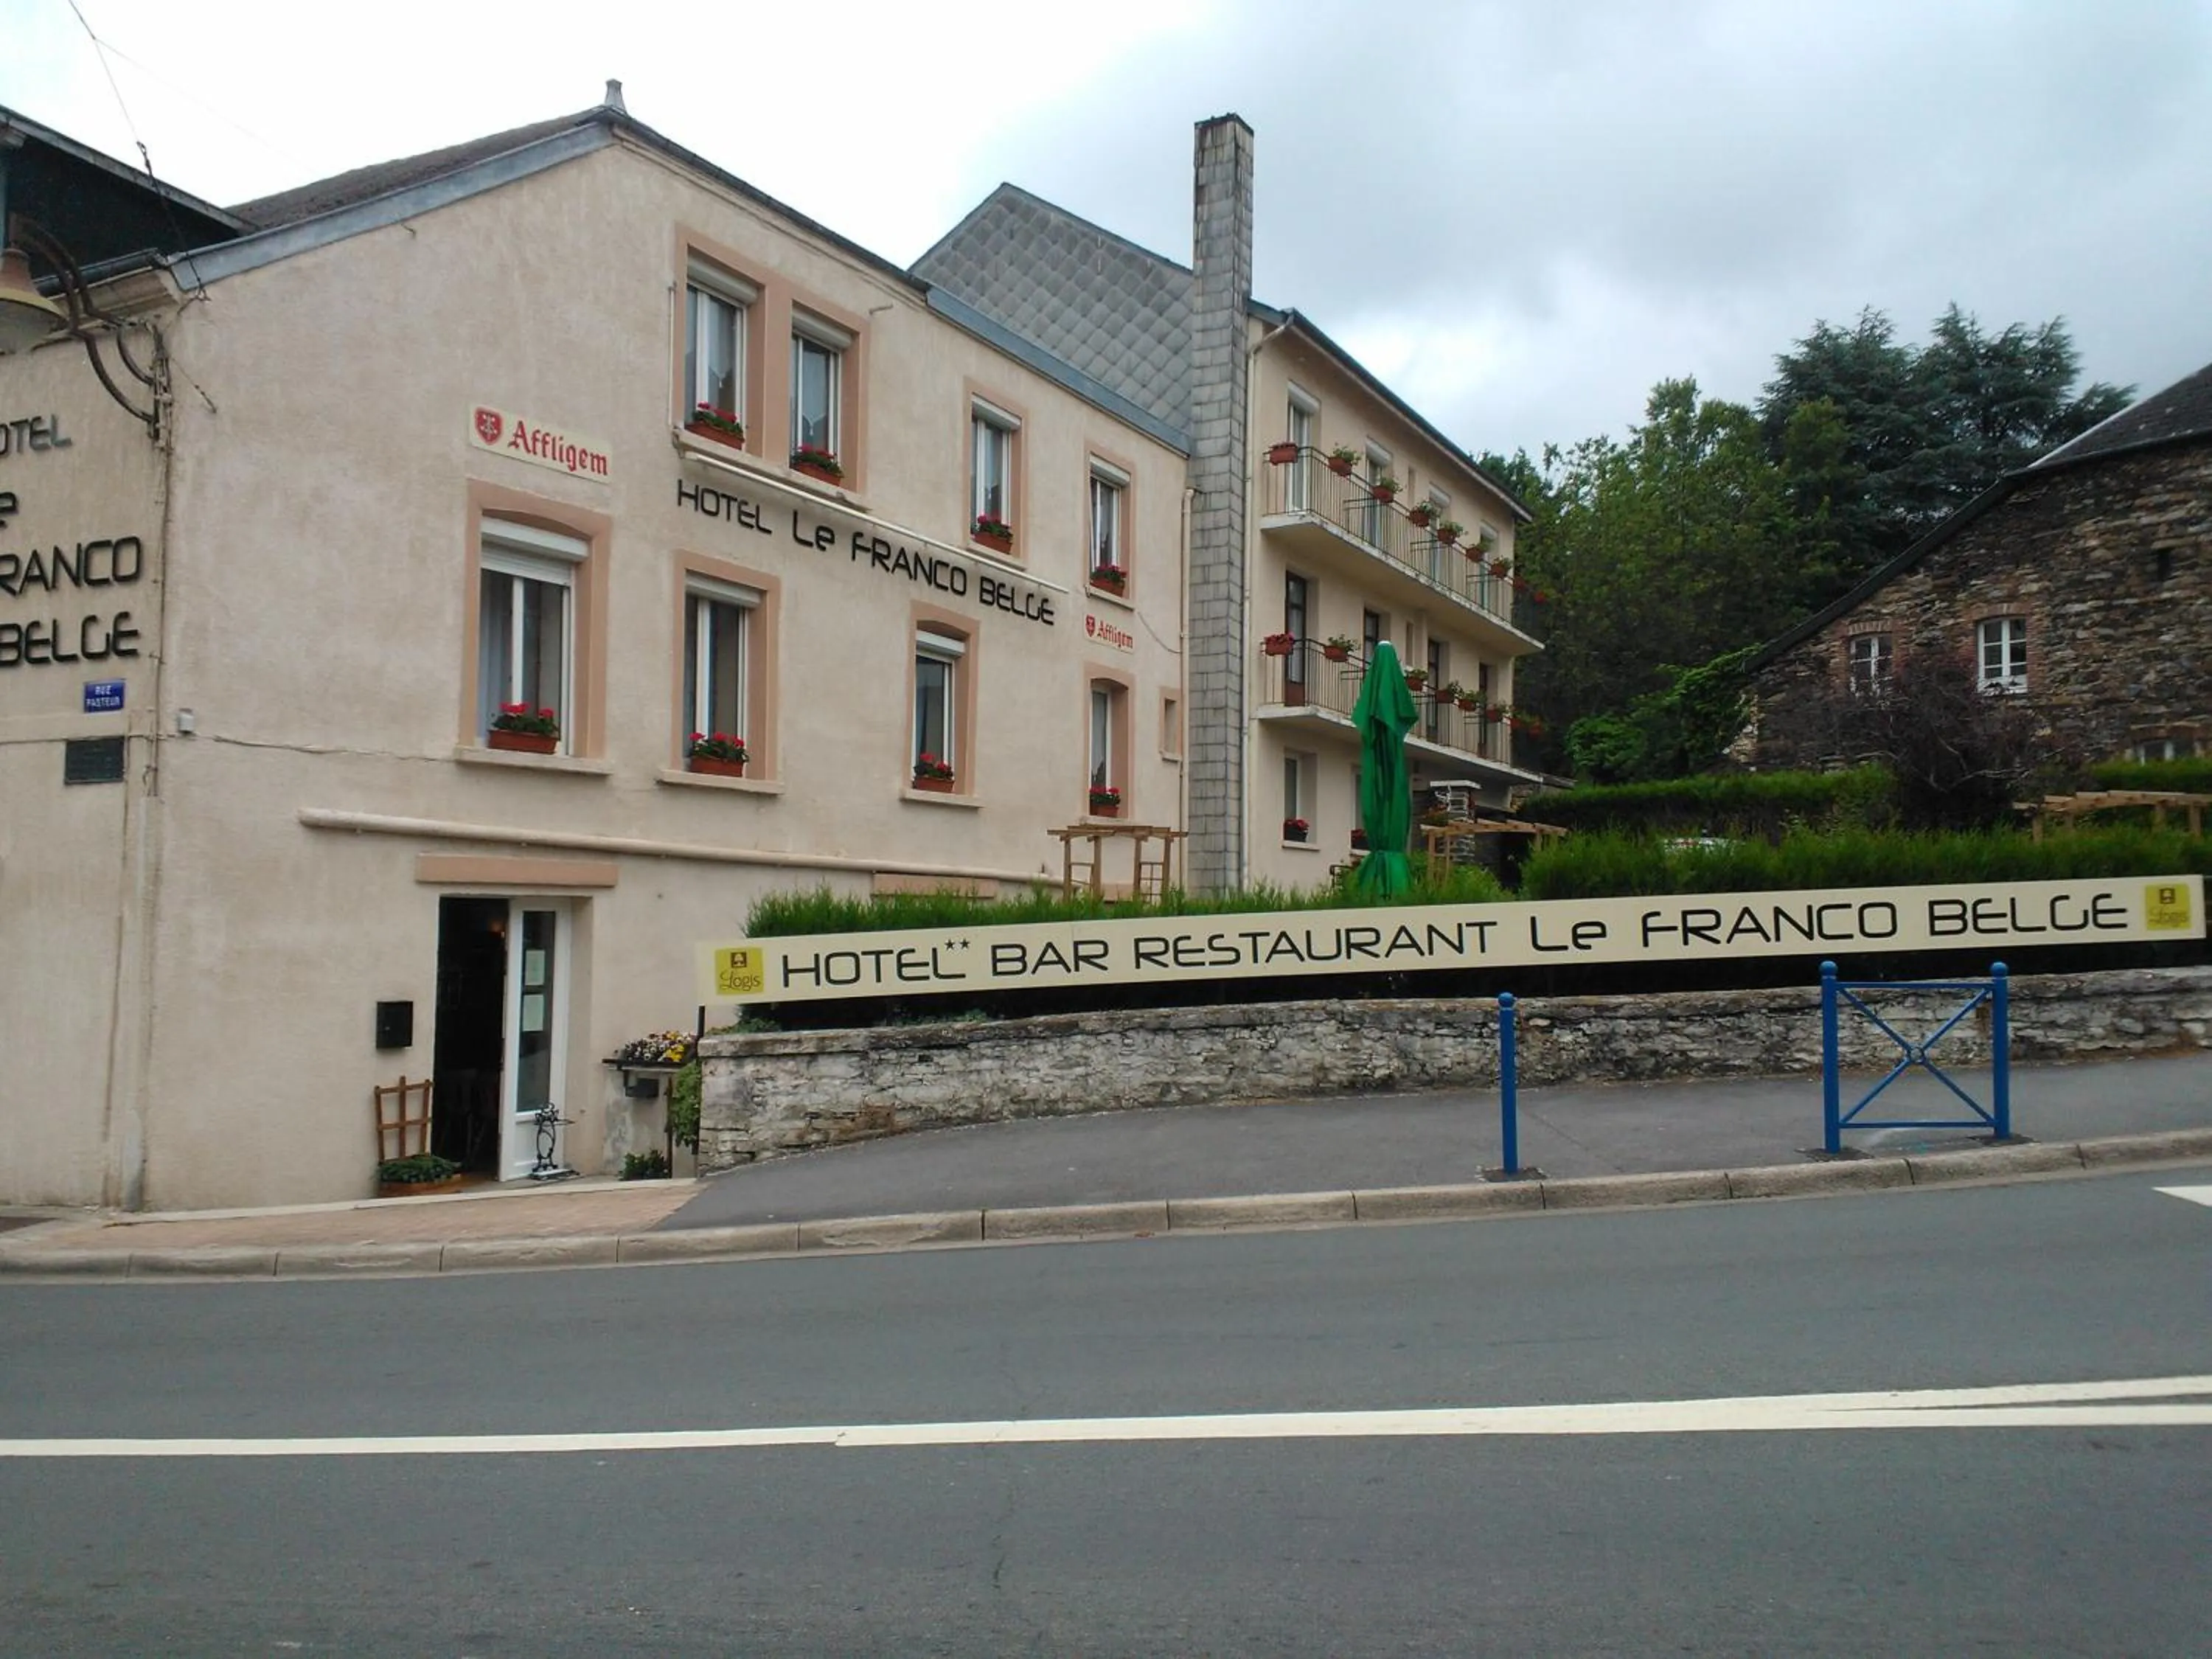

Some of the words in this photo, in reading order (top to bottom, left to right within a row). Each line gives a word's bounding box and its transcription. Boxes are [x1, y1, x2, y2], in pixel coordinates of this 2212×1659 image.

[507, 420, 608, 476] Affligem
[678, 479, 772, 535] HOTEL
[793, 509, 835, 552] Le
[851, 531, 967, 597] FRANCO
[979, 576, 1054, 625] BELGE
[0, 611, 140, 664] BELGE
[1097, 620, 1133, 649] Affligem
[782, 947, 966, 987] HOTEL
[991, 939, 1110, 976] BAR
[1133, 921, 1498, 970] RESTAURANT
[1530, 913, 1607, 952] Le
[1641, 901, 1898, 947] FRANCO
[1928, 893, 2128, 936] BELGE
[720, 970, 762, 992] Logis
